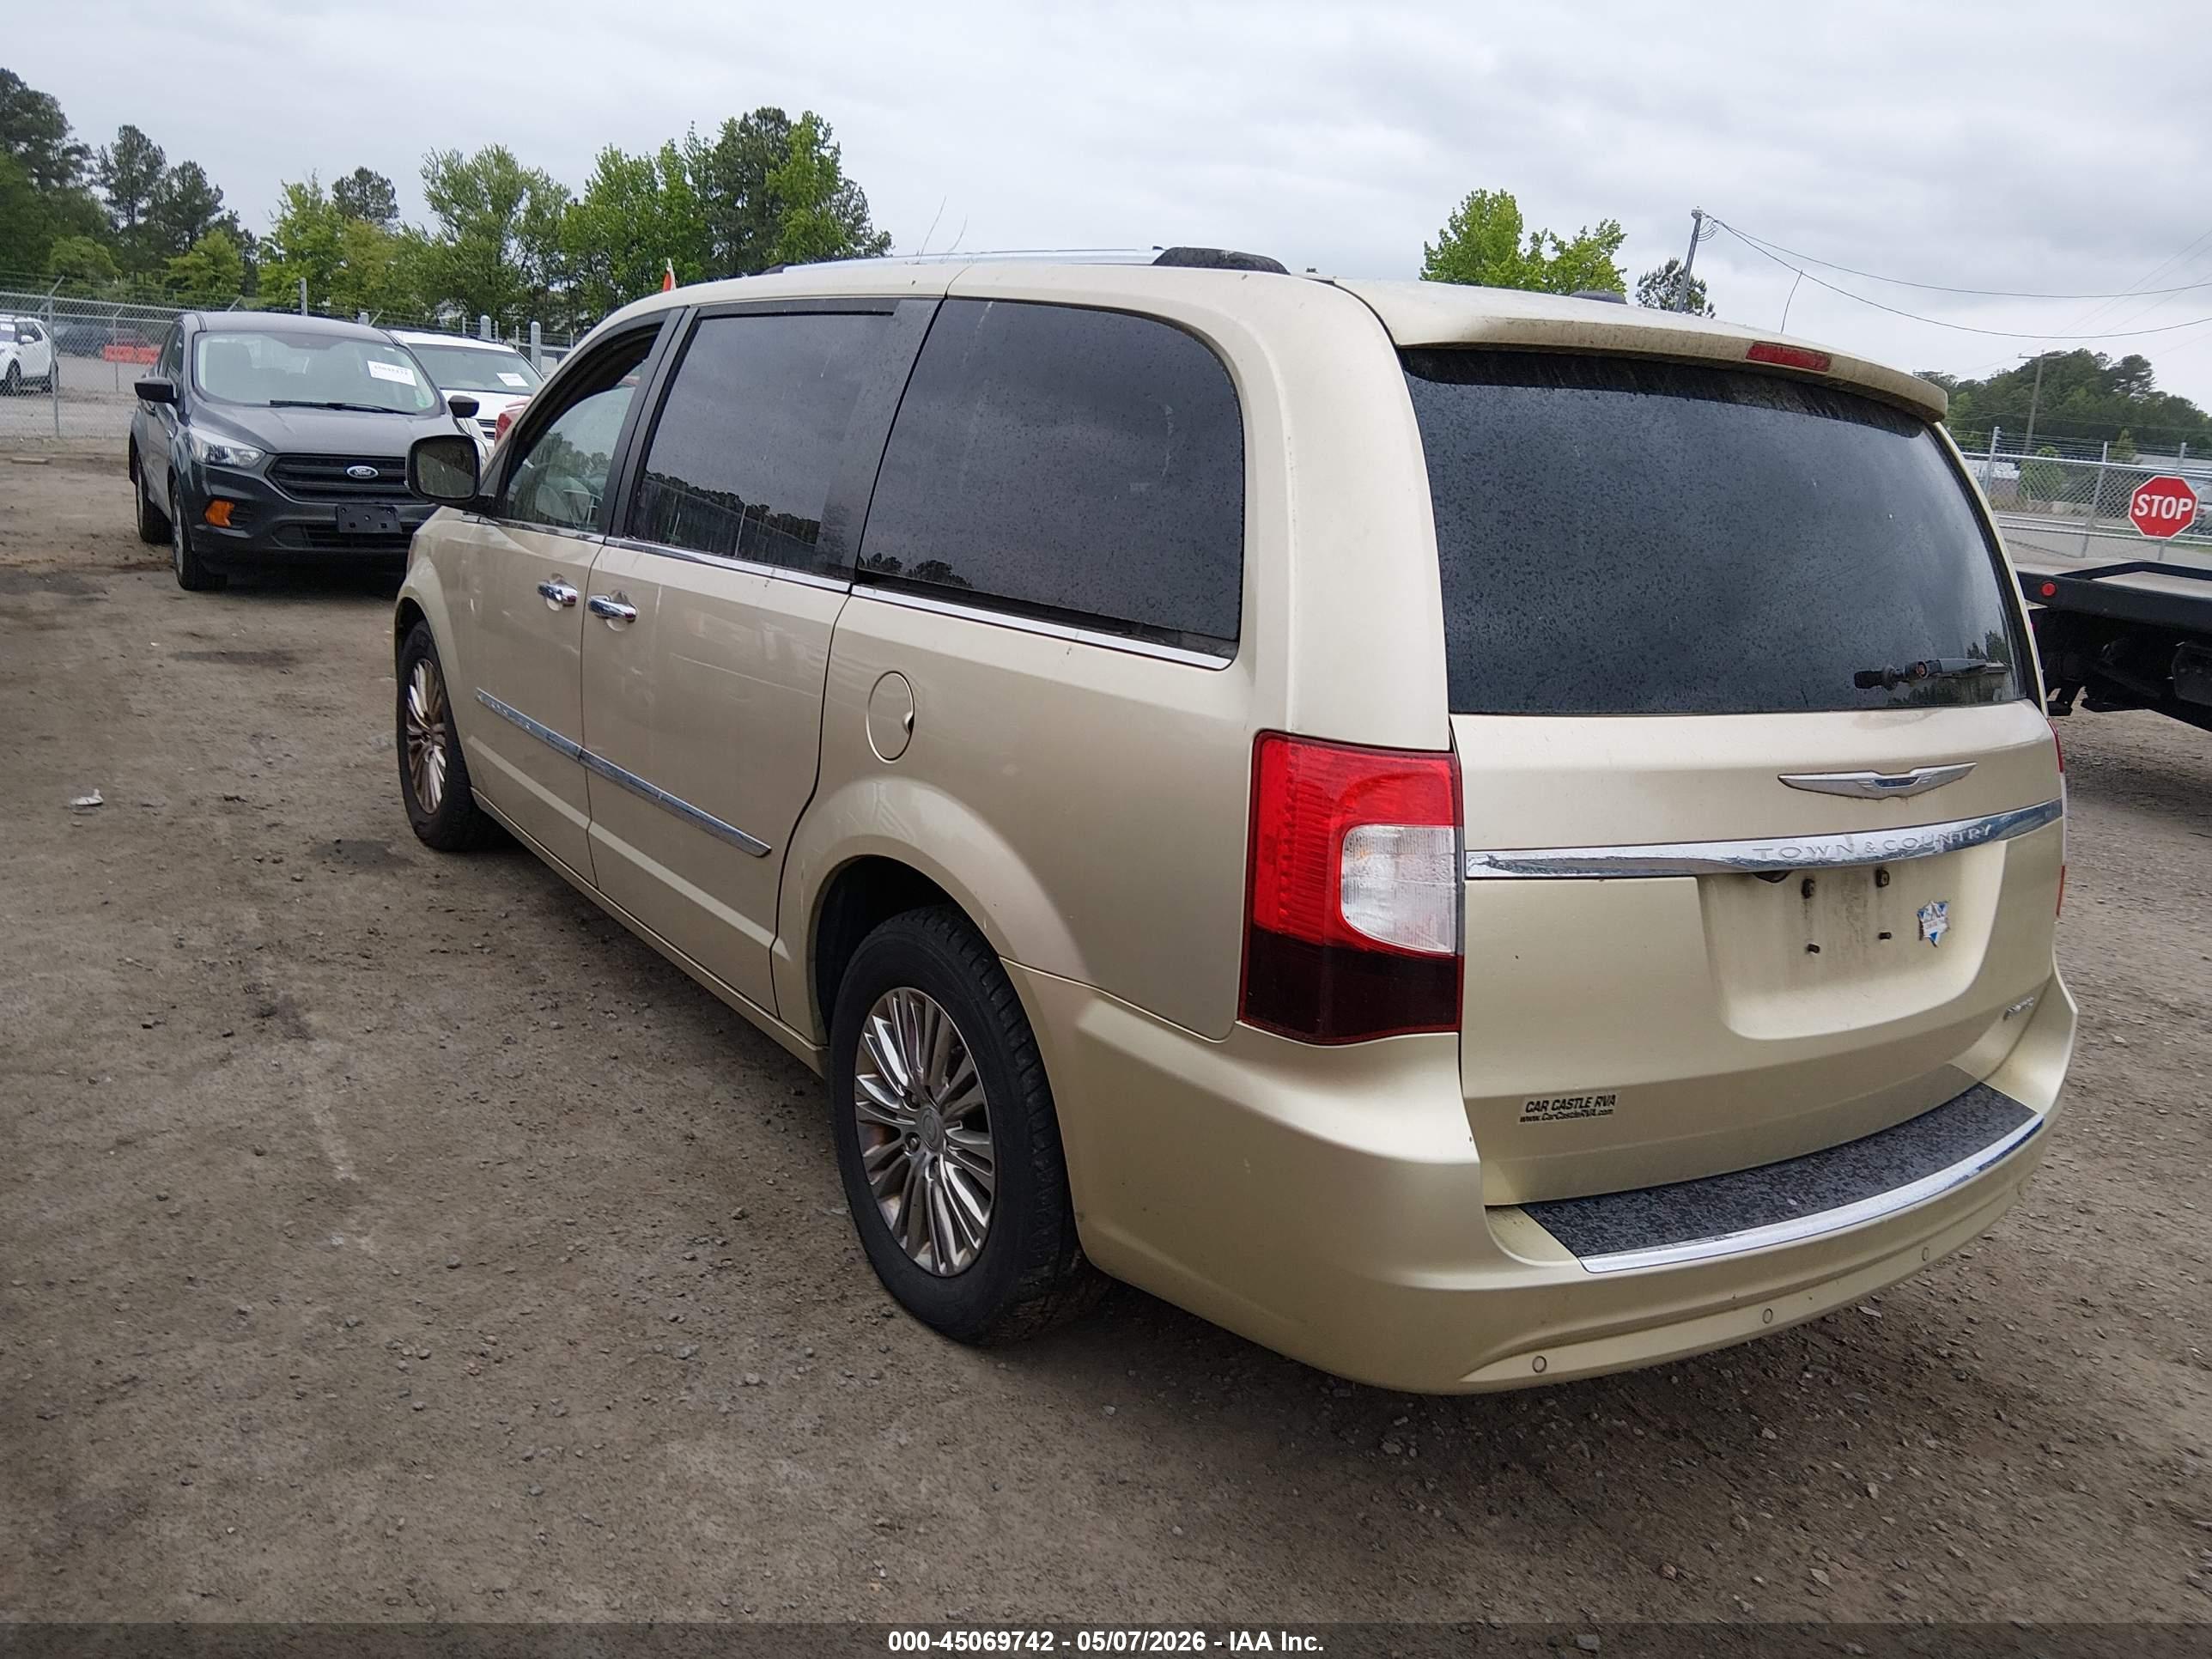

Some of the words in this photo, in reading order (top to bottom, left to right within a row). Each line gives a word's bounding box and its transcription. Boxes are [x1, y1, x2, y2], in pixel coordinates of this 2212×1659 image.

[2134, 494, 2193, 520] STOP
[1751, 842, 1855, 860] TOWN
[1864, 841, 1878, 854] &
[1882, 823, 1992, 852] COUNTRY
[1525, 1100, 1549, 1114] CAR
[1551, 1097, 1593, 1111] CASTLE
